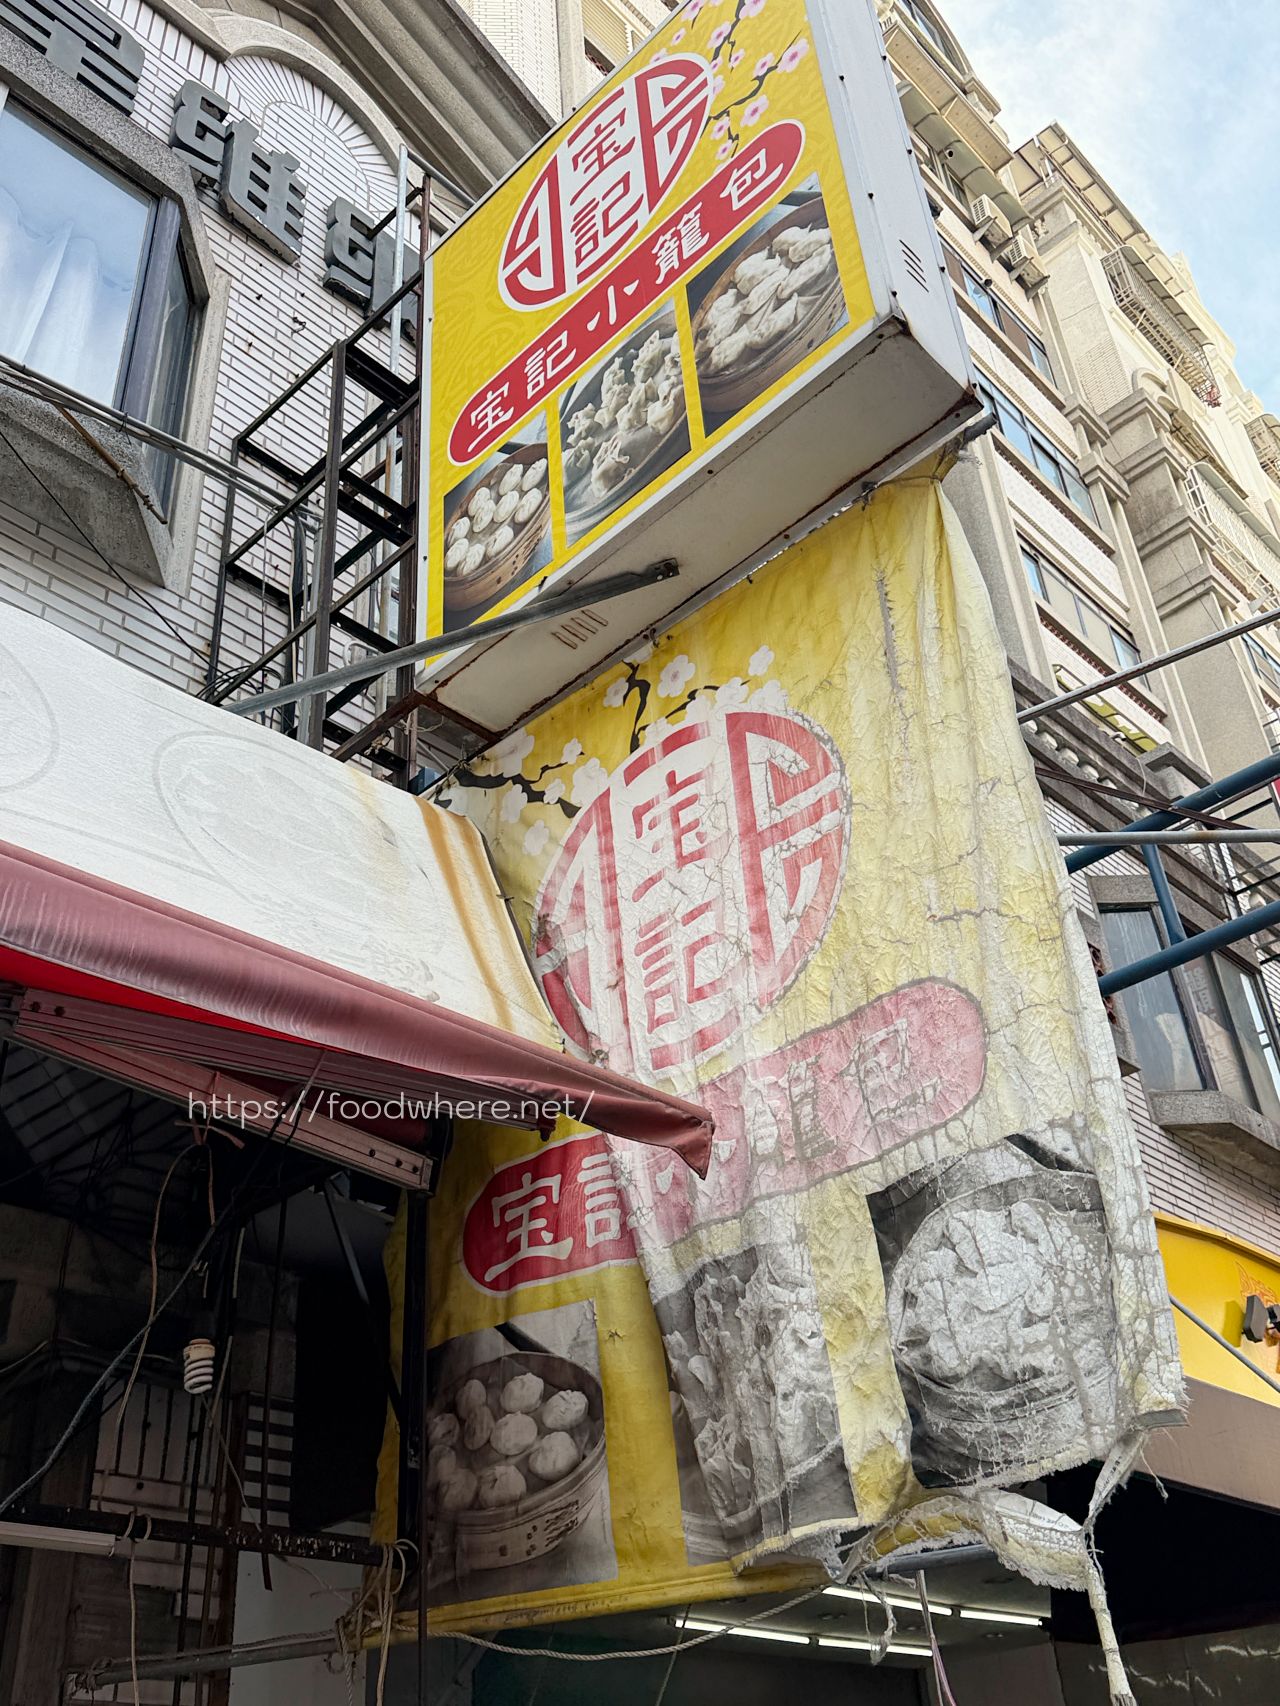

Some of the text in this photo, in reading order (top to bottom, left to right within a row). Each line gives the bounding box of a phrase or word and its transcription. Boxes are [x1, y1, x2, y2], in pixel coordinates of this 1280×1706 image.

[467, 147, 785, 452] 宝記小籠包
[569, 108, 645, 267] 宝記
